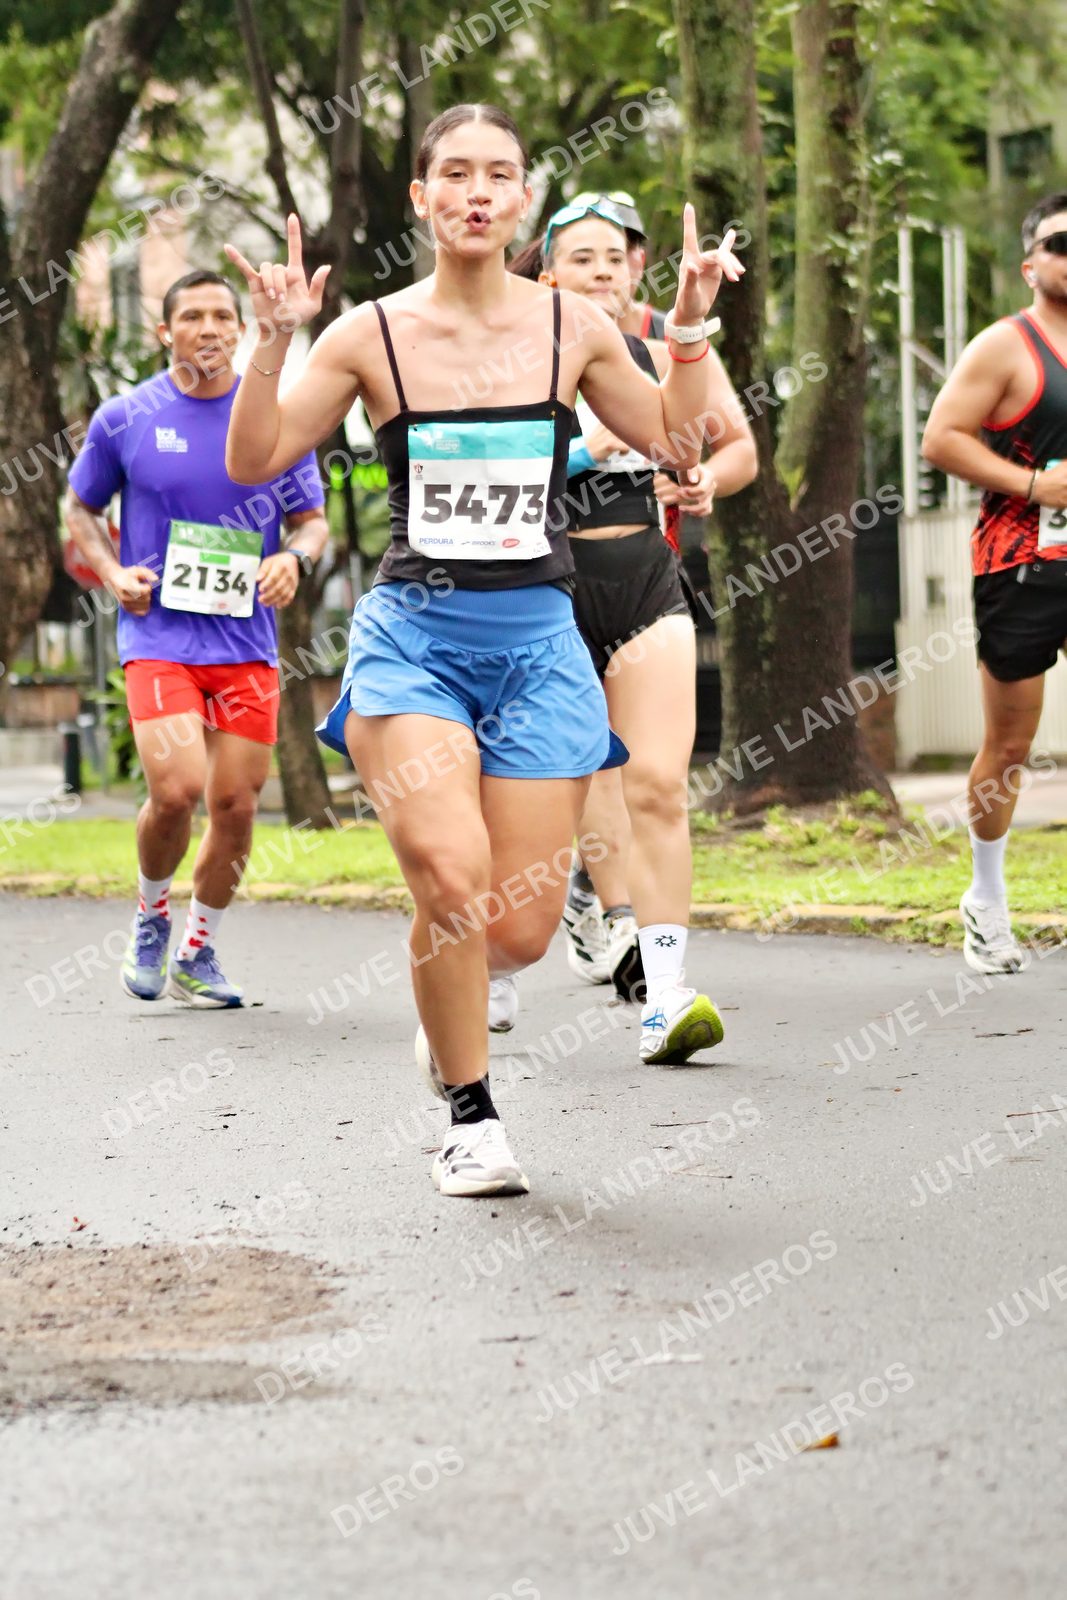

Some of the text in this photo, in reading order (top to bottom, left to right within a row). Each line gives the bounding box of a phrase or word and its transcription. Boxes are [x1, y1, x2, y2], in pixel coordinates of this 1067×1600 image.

[420, 484, 545, 525] 5473
[419, 537, 454, 545] PERDURA
[171, 563, 249, 597] 2134
